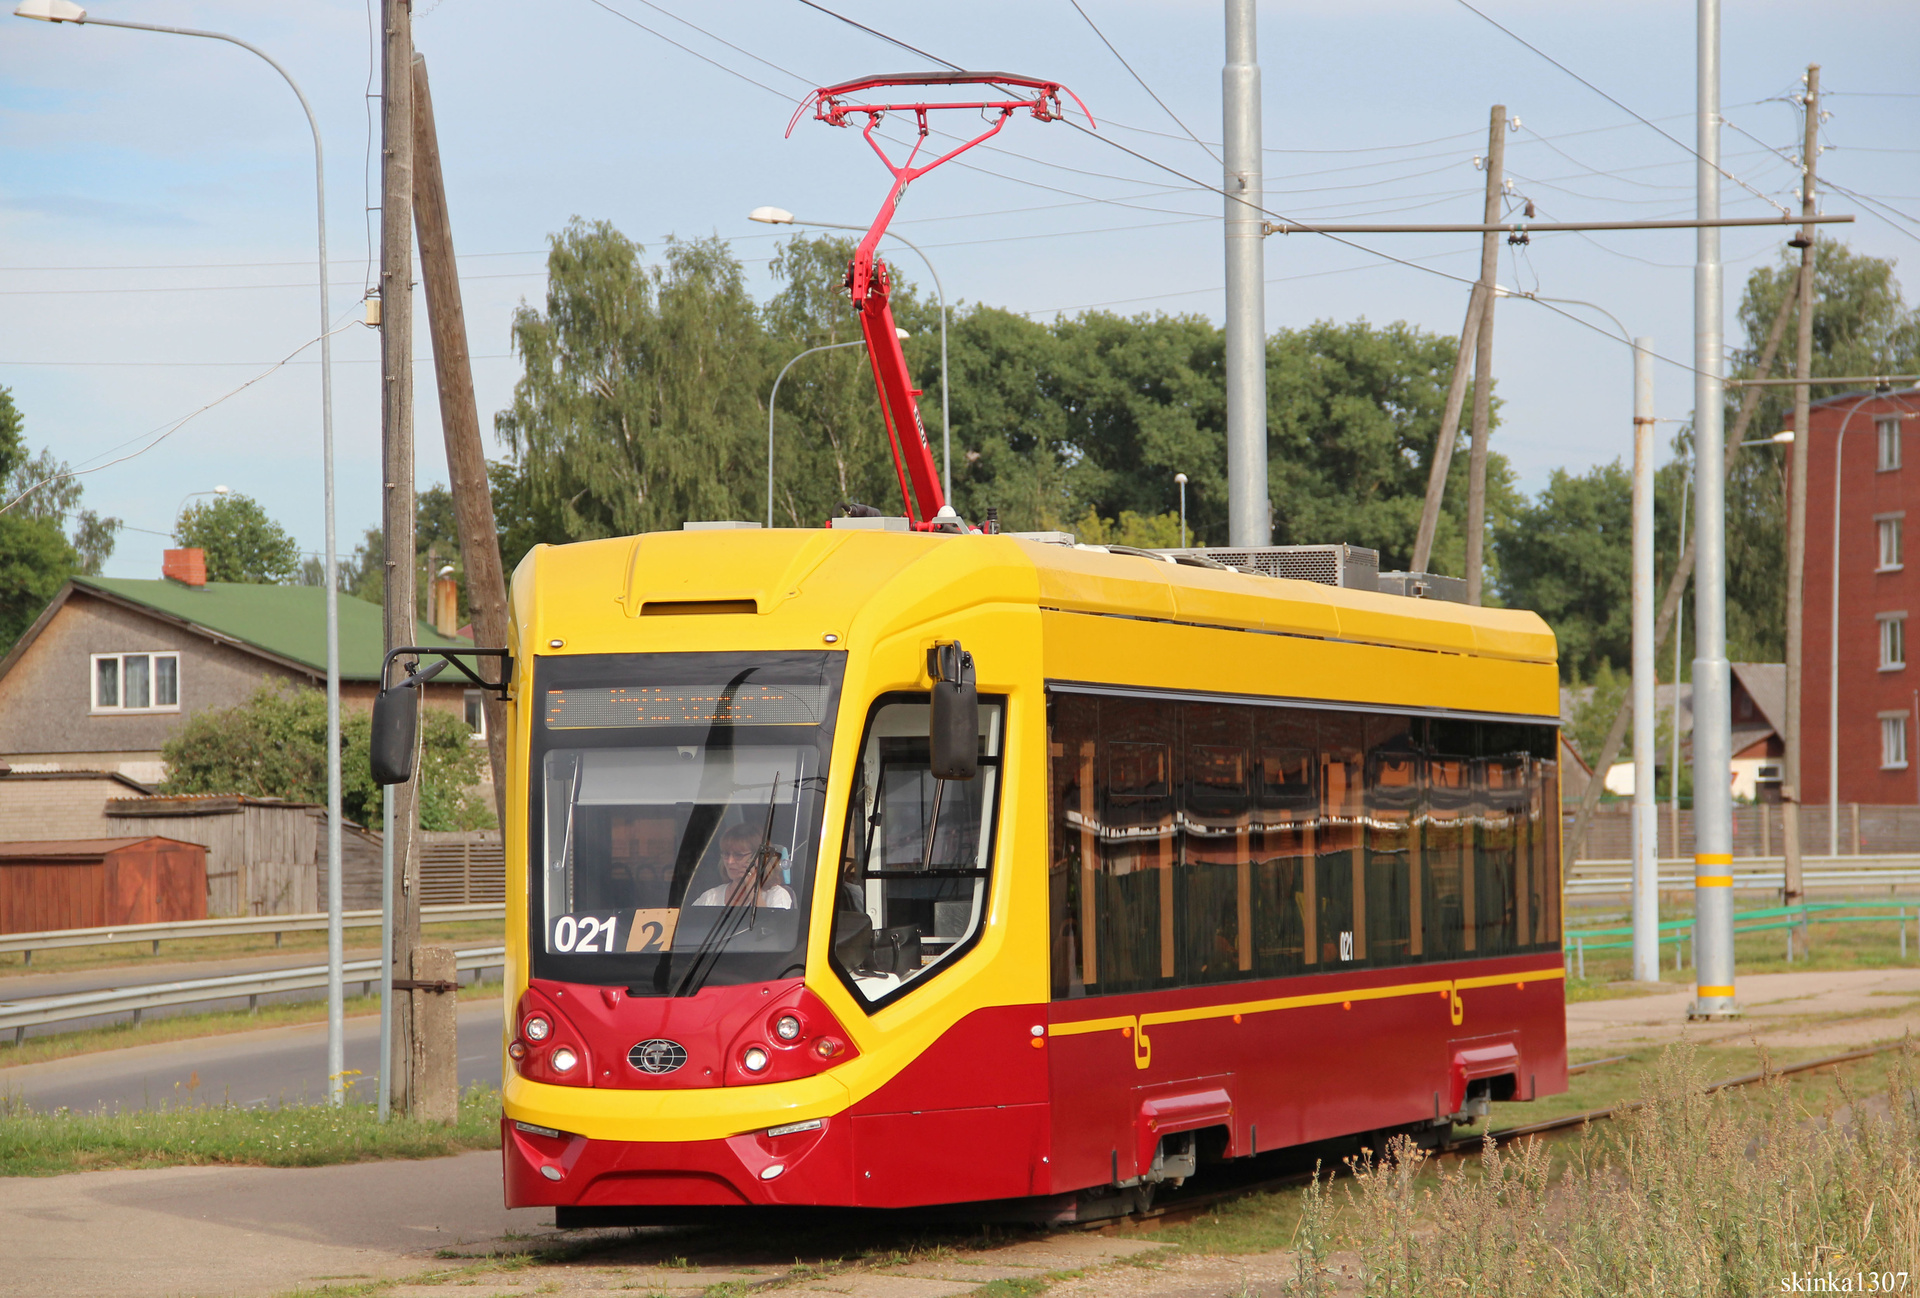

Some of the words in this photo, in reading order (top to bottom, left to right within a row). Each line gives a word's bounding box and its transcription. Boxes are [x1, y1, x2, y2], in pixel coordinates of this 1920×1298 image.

[554, 916, 617, 952] 021
[641, 921, 664, 952] 2
[1340, 931, 1353, 961] 021
